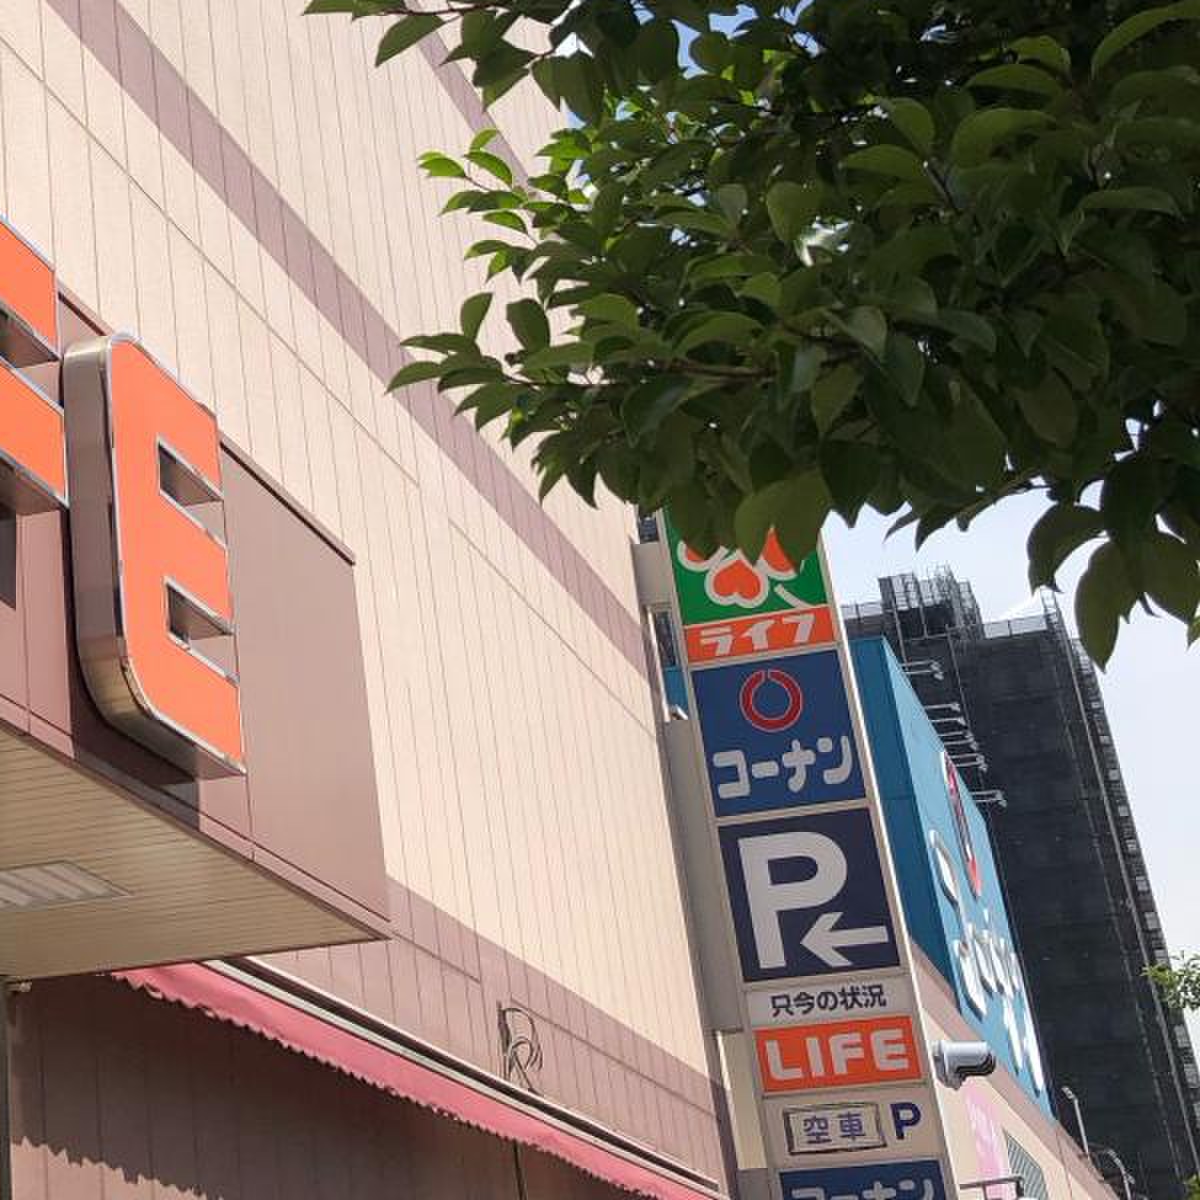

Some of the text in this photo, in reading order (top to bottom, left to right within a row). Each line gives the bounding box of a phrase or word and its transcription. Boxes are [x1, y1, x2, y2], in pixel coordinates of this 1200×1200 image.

[700, 614, 815, 656] ライフ
[712, 735, 852, 799] コーナン
[739, 832, 847, 969] P
[770, 984, 887, 1017] 只今の状況
[765, 1028, 909, 1081] LIFE
[803, 1102, 921, 1144] 空車 P
